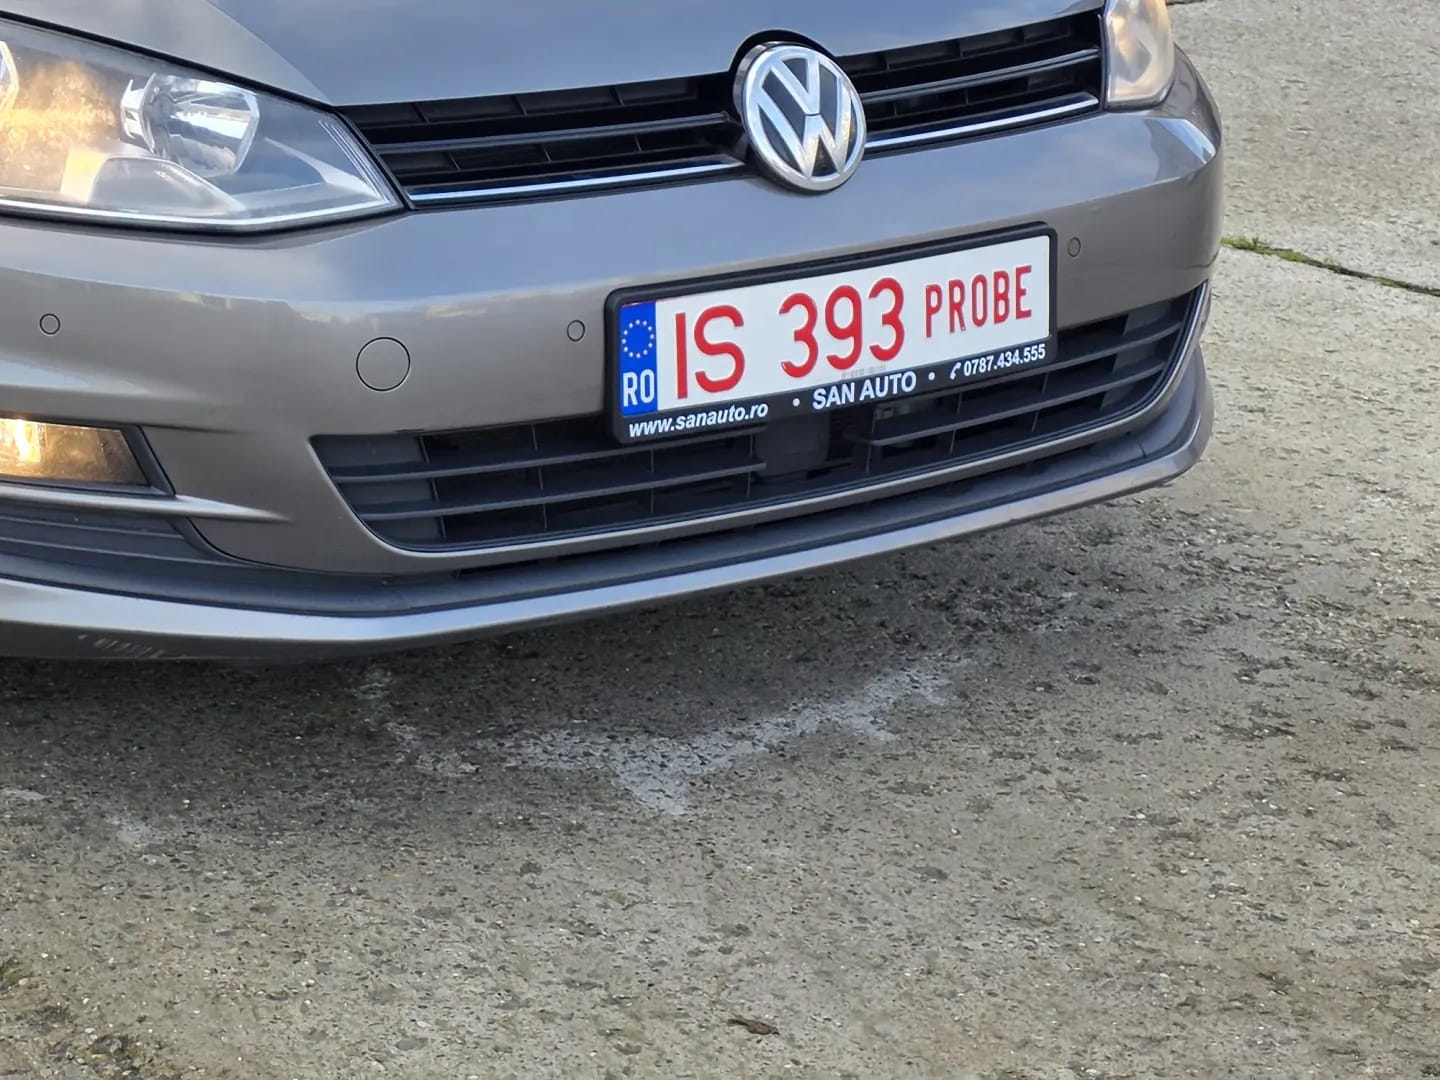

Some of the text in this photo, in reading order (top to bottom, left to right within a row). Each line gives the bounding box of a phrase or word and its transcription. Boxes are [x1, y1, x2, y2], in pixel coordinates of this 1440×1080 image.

[675, 265, 1032, 399] IS 393 PROBE
[623, 369, 654, 407] RO
[629, 403, 768, 438] www.sanauto.ro
[812, 383, 855, 410] SAN
[859, 371, 917, 401] AUTO
[963, 343, 1046, 376] 0787.434.555
